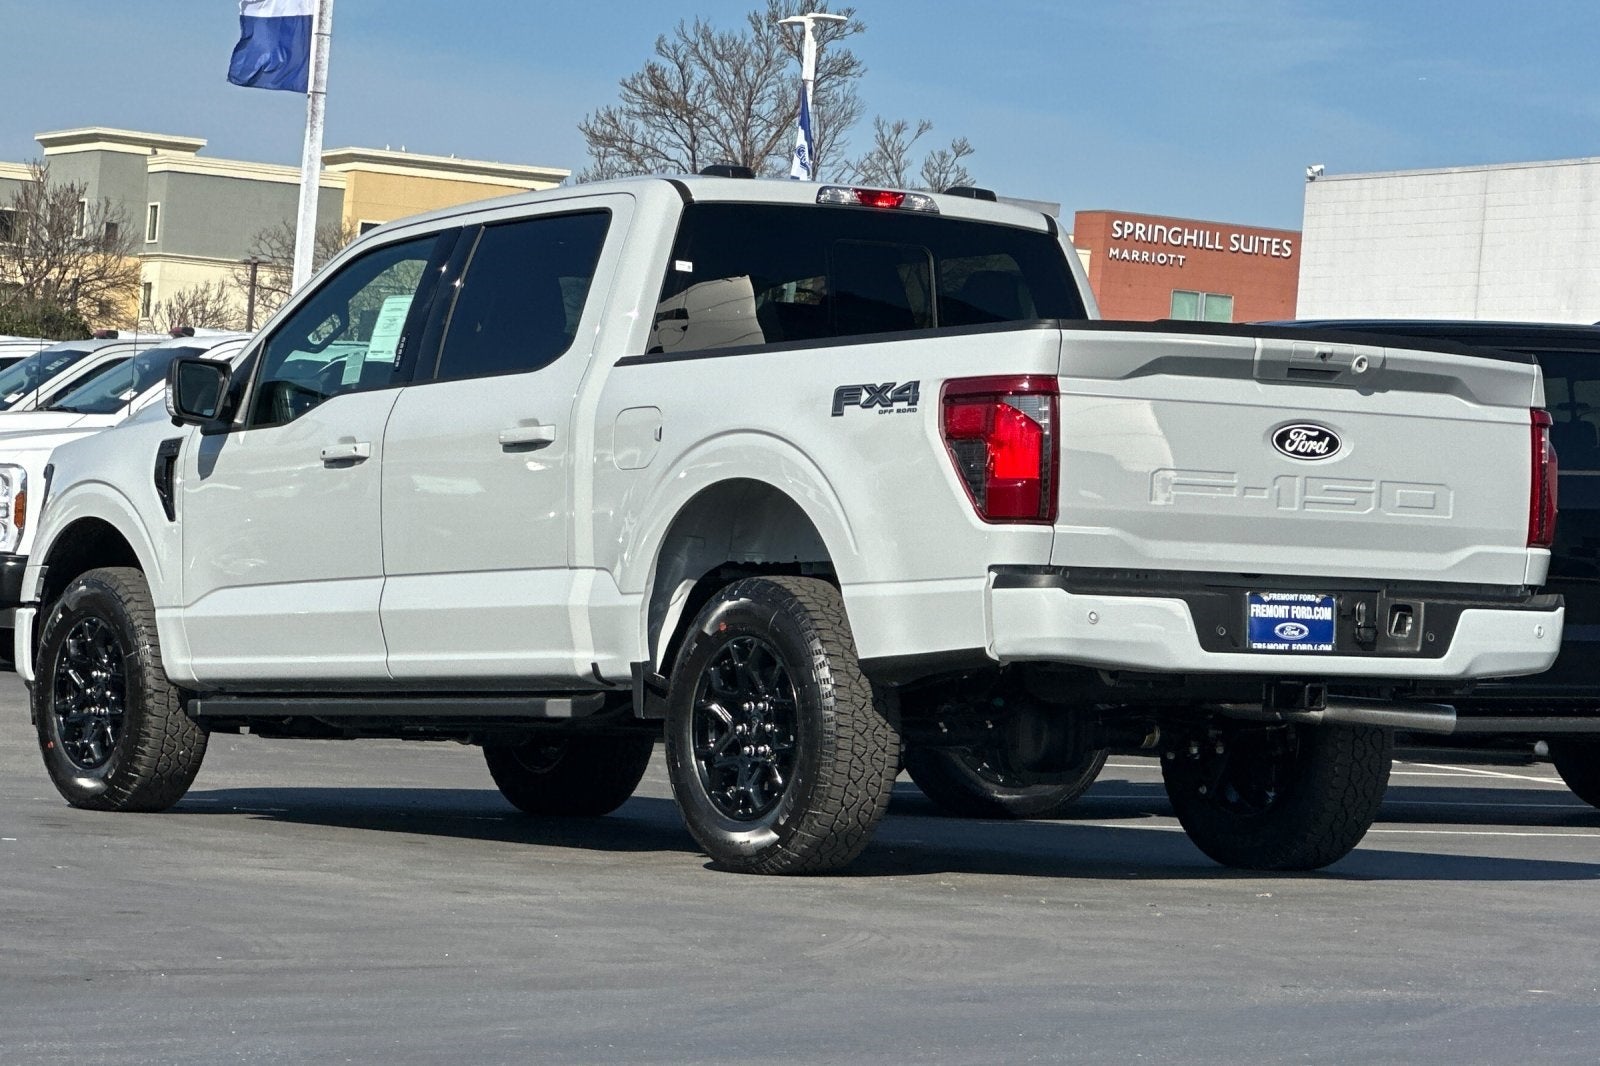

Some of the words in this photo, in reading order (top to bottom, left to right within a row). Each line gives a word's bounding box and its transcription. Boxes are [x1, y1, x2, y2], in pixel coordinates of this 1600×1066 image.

[1111, 220, 1223, 249] SPRINGHILL
[1229, 233, 1292, 257] SUITES
[1108, 248, 1186, 267] MARRIOTT
[832, 380, 920, 417] FX4
[1284, 427, 1330, 455] Ford
[1150, 468, 1453, 519] F-150
[1269, 593, 1298, 601] FREMONT
[1299, 594, 1316, 602] FORD
[1250, 604, 1289, 618] FREMONT
[1291, 606, 1332, 620] FORD.COM
[1283, 626, 1300, 636] Ford
